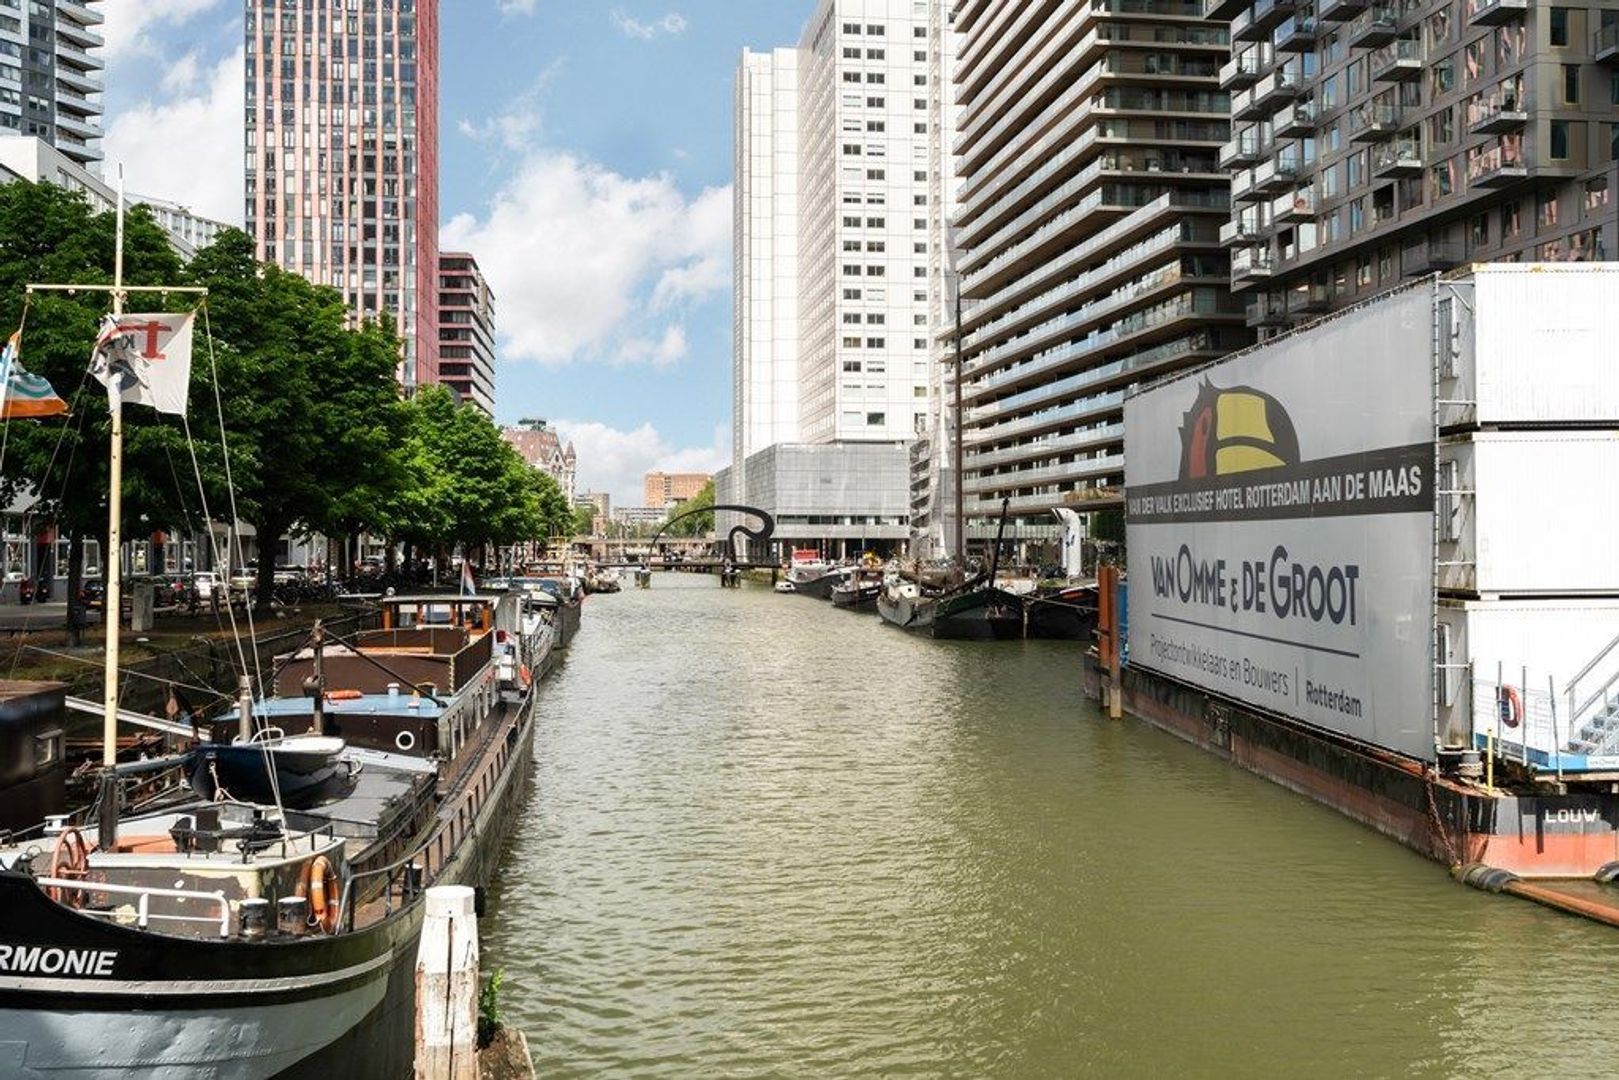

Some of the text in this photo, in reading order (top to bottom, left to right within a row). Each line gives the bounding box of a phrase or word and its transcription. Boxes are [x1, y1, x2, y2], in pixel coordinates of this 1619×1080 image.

[1142, 495, 1155, 514] DER
[1216, 487, 1244, 510] HOTEL
[1246, 479, 1310, 509] ROTTERDAM
[1312, 476, 1341, 503] AAN
[1345, 472, 1364, 500] DE
[1369, 465, 1421, 498] MAAS
[1151, 556, 1175, 598] VAN
[1242, 561, 1266, 613] DE
[1269, 545, 1359, 626] GROOT
[1230, 660, 1241, 681] en
[1243, 658, 1289, 696] Bouwers
[1306, 680, 1362, 718] Rotterdam
